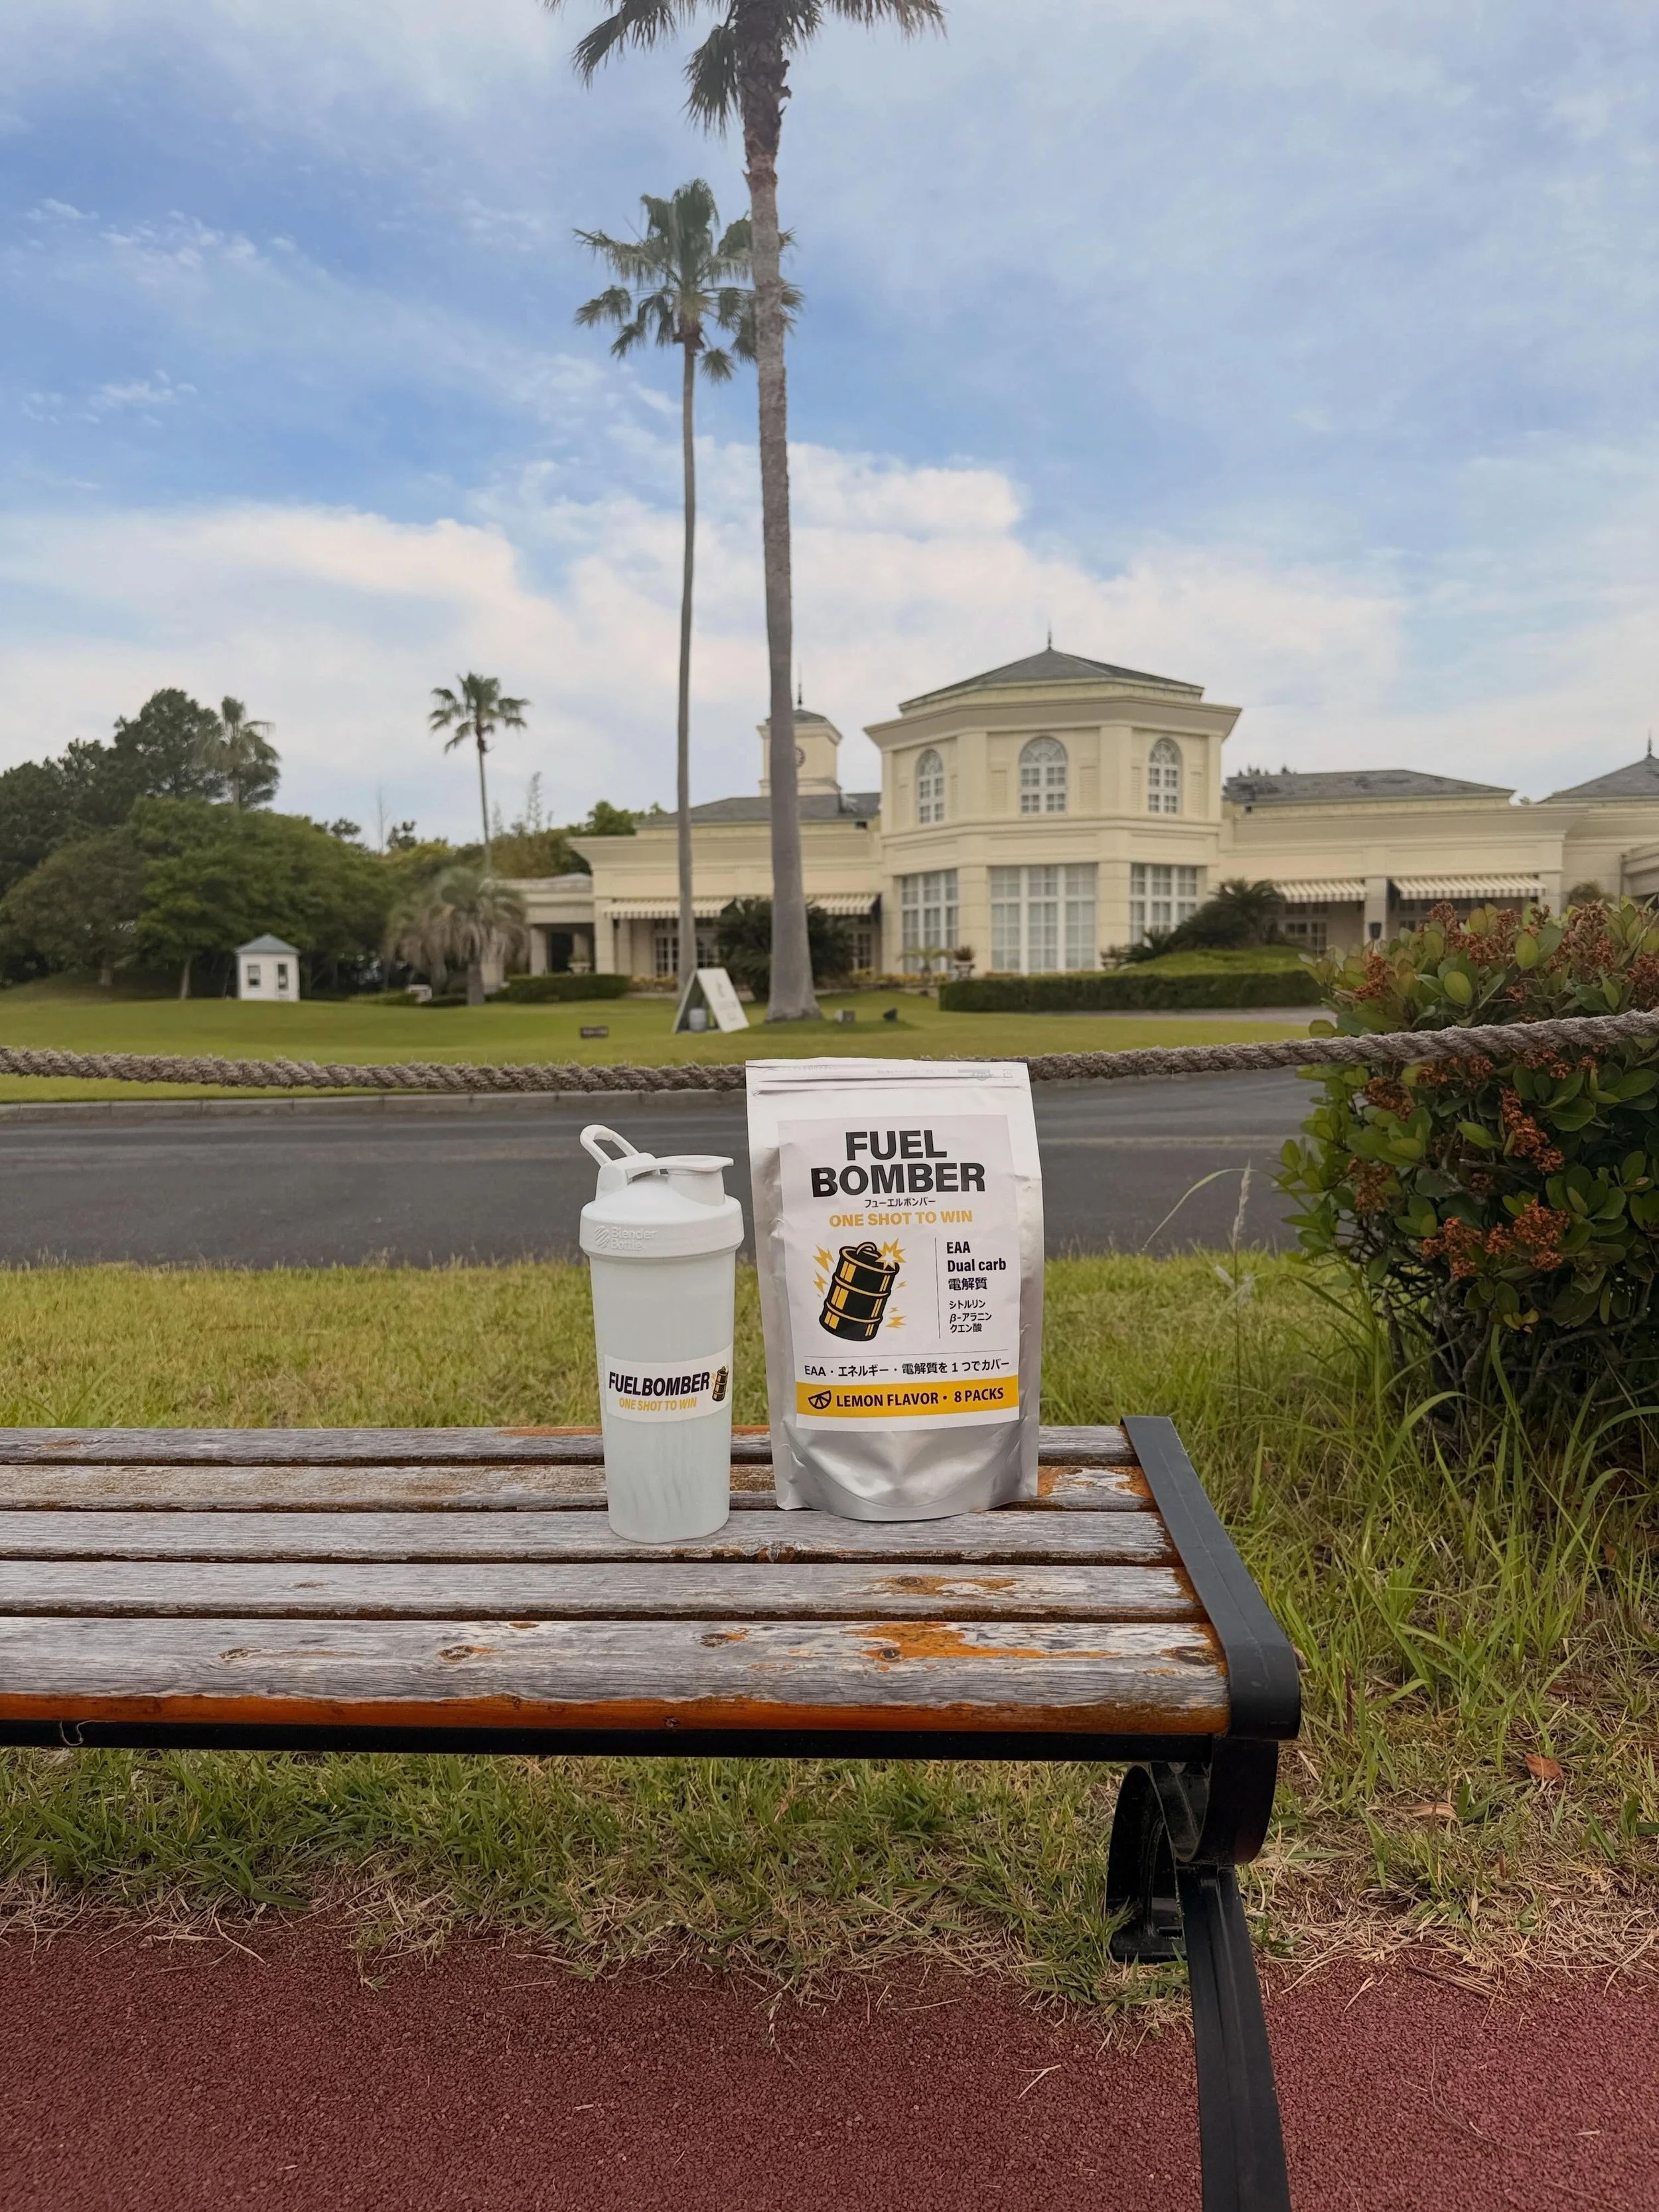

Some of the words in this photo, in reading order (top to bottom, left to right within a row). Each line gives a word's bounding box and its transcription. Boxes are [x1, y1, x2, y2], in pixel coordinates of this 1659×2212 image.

[845, 1130, 948, 1161] FUEL
[811, 1162, 985, 1198] BOMBER
[865, 1197, 936, 1208] フューエルボンバー
[830, 1215, 864, 1227] ONE
[867, 1212, 912, 1226] SHOT
[915, 1211, 937, 1224] TO
[940, 1210, 973, 1223] WIN
[611, 1226, 658, 1239] Blender
[610, 1238, 643, 1250] Bottle
[946, 1241, 971, 1254] EAA
[947, 1258, 975, 1272] Dual
[978, 1257, 1007, 1271] carb
[948, 1277, 987, 1291] 電解質
[949, 1299, 986, 1309] シトルリン
[950, 1312, 992, 1324] β-アラニン
[950, 1323, 982, 1333] クエン酸
[609, 1371, 710, 1396] FUELBOMBER
[619, 1398, 636, 1410] ONE
[638, 1399, 662, 1412] SHOT
[664, 1400, 678, 1411] TO
[679, 1396, 697, 1410] WIN
[836, 1394, 883, 1408] LEMON
[887, 1392, 939, 1406] FLAVOR
[954, 1391, 962, 1403] 8
[965, 1387, 1004, 1402] PACKS
